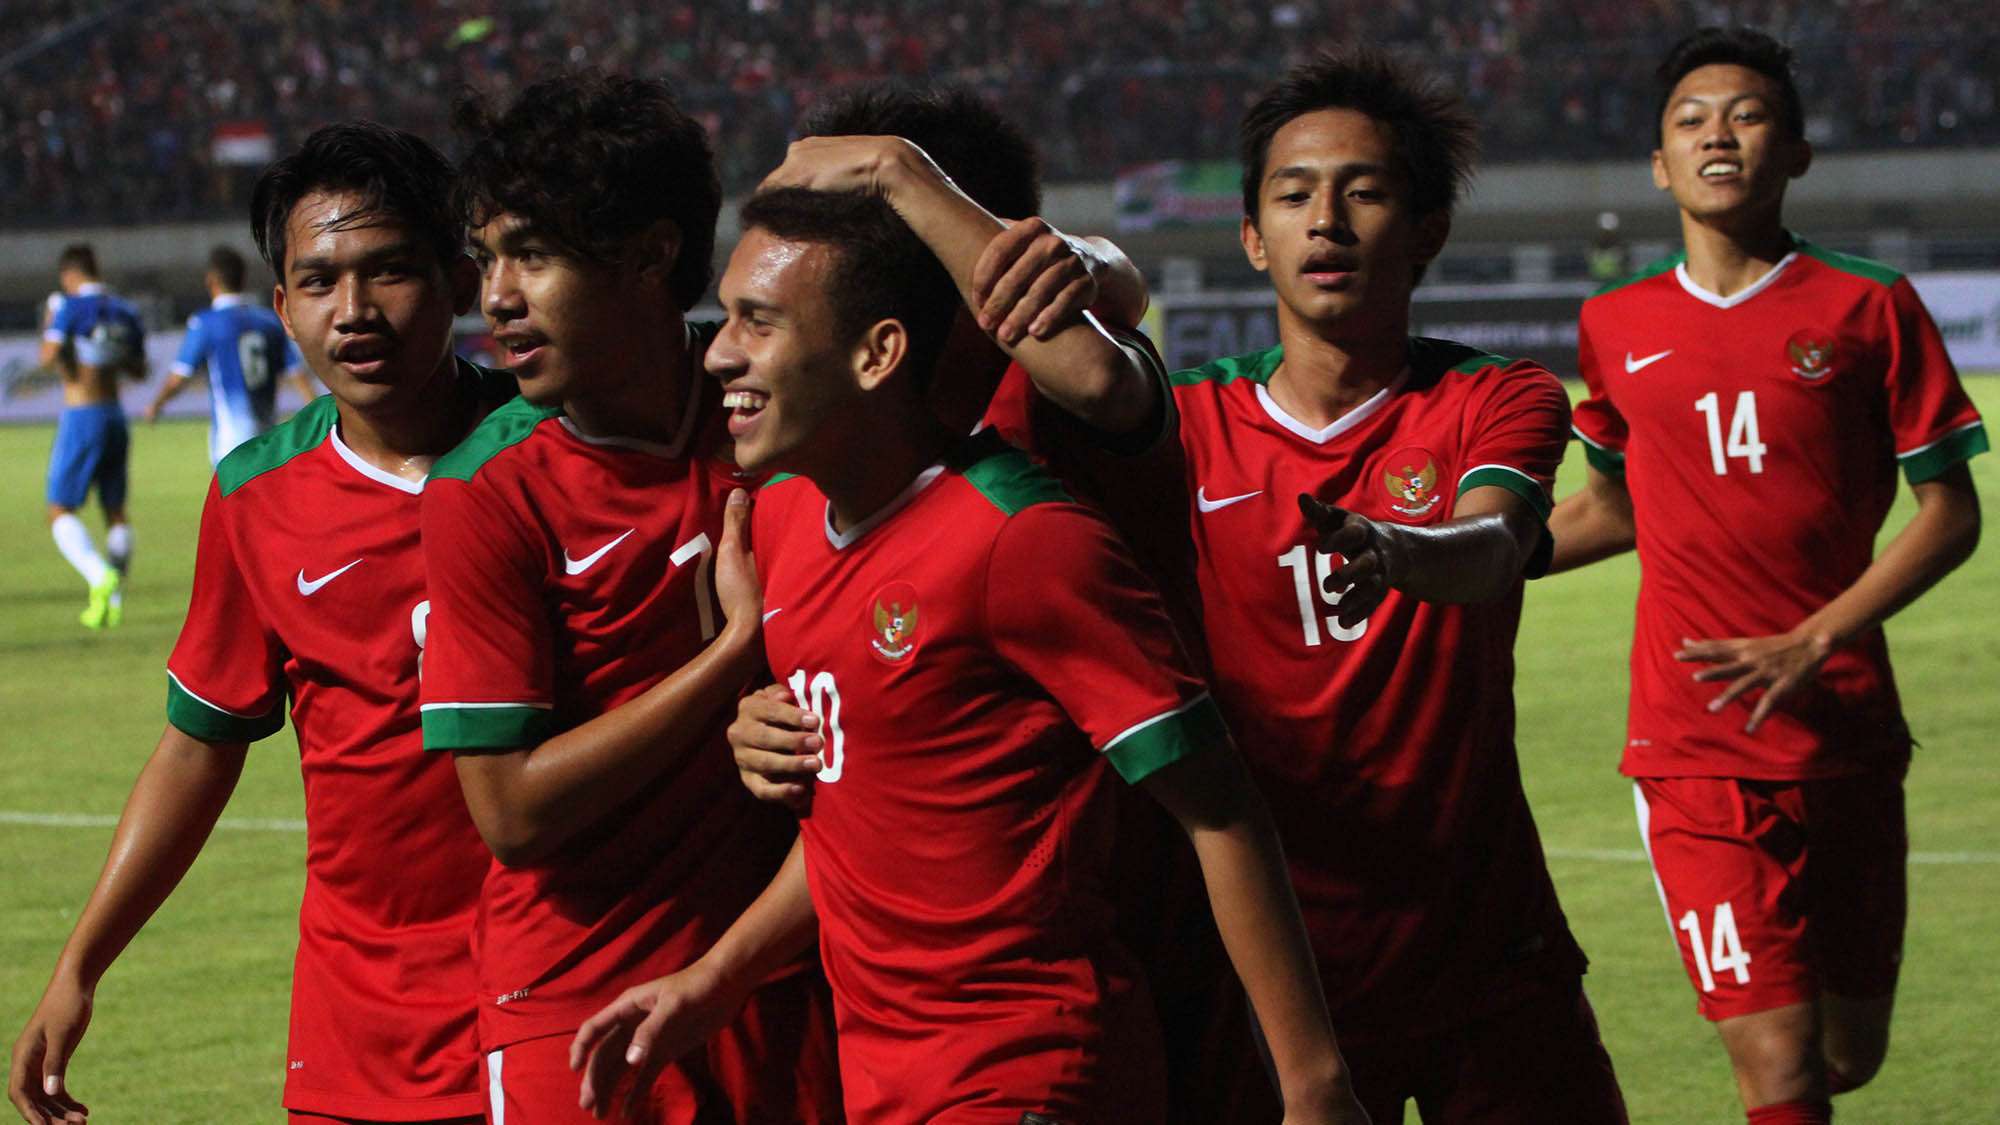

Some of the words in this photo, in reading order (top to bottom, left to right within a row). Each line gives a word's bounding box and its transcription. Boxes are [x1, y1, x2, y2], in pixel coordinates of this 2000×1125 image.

[238, 330, 269, 391] 6
[1695, 391, 1767, 475] 14
[669, 532, 715, 641] 7
[1679, 902, 1751, 992] 14
